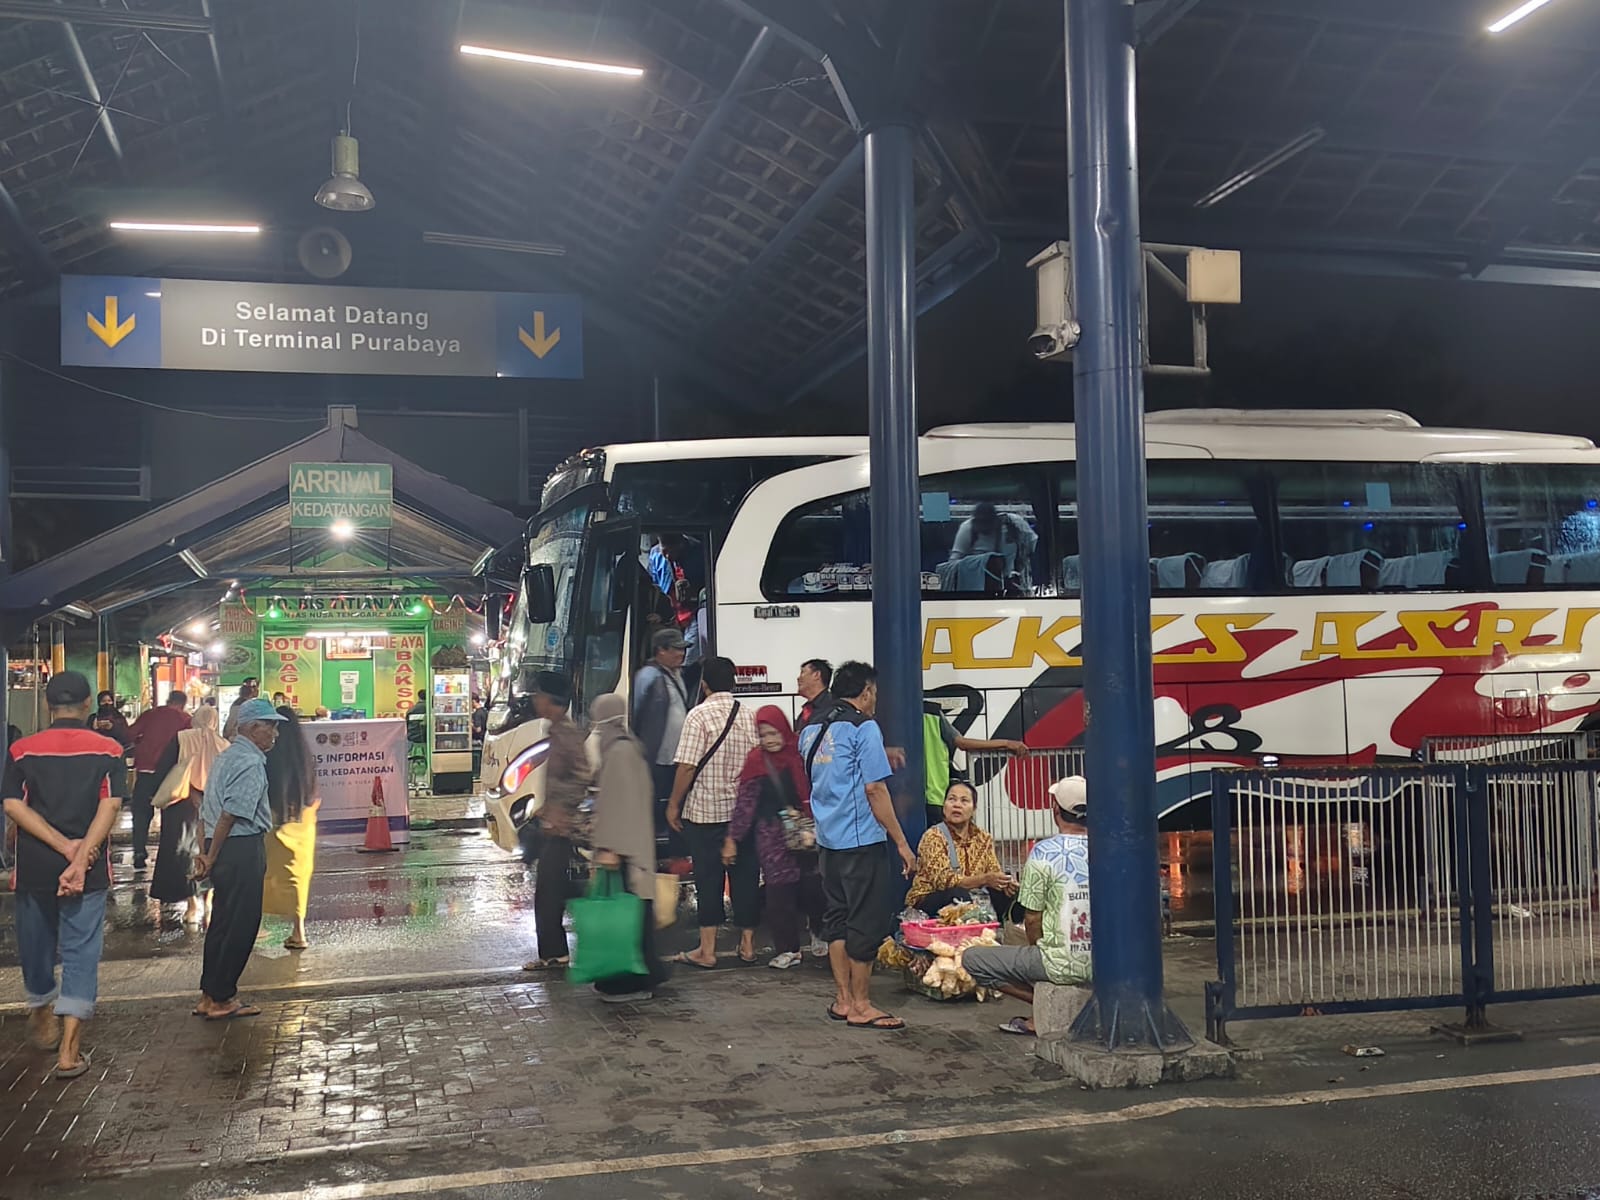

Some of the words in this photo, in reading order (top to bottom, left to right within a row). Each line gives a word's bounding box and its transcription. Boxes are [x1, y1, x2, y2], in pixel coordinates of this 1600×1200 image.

[235, 301, 336, 323] Selamat
[345, 305, 429, 330] Datang
[201, 327, 226, 346] Di
[234, 328, 341, 350] Terminal
[351, 333, 461, 357] Purabaya
[291, 469, 391, 495] ARRIVAL
[292, 502, 391, 518] KEDATANGAN
[264, 637, 318, 652] SOTO
[921, 613, 1275, 670] AKS
[1300, 607, 1600, 661] ASRI
[394, 650, 414, 709] BAKSO
[326, 751, 385, 763] INFORMASI
[331, 765, 394, 777] KEDATANGAN
